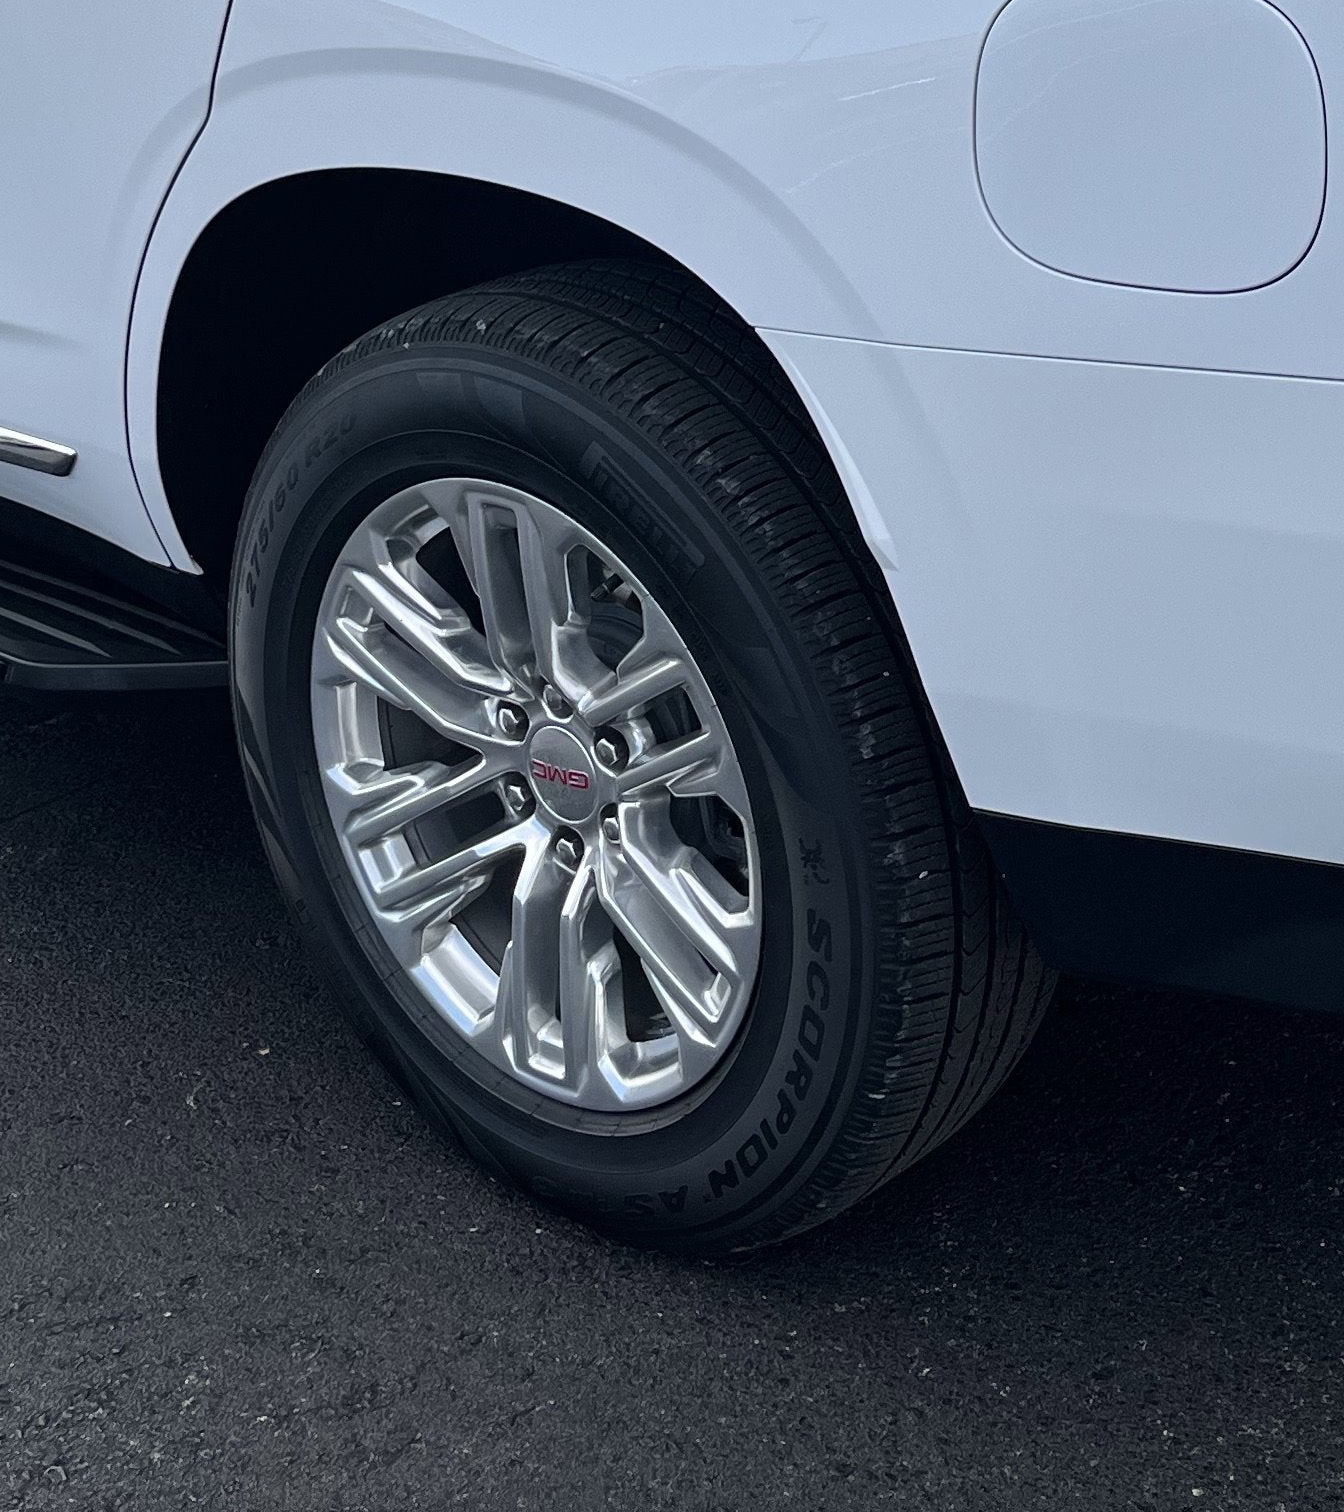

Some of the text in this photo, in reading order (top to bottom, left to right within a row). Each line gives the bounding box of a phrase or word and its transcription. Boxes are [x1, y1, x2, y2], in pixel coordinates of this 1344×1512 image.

[245, 461, 300, 609] 275/60
[531, 757, 590, 790] GMC
[707, 907, 833, 1200] SCORPION
